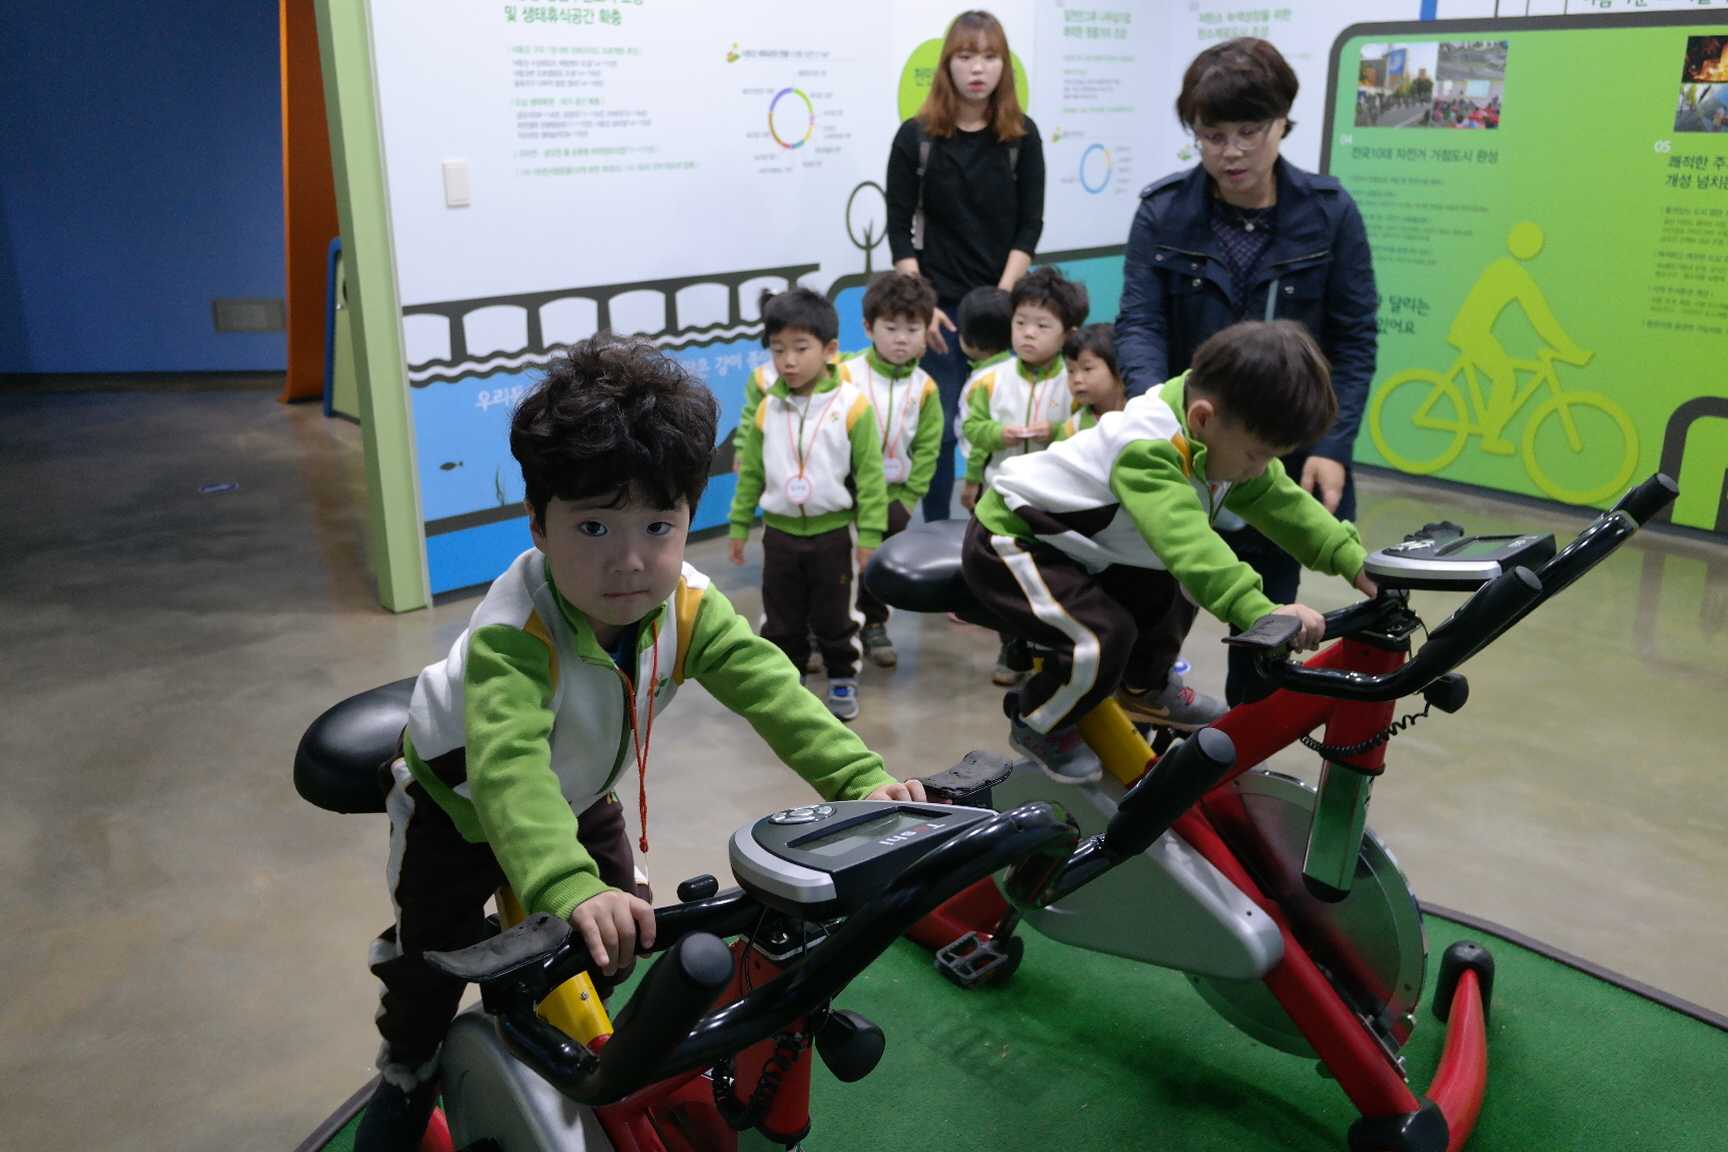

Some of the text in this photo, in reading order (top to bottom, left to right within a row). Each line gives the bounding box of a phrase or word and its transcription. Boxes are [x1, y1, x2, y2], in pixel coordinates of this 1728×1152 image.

[504, 5, 622, 26] 및 생태휴식공간 확충
[1396, 147, 1426, 162] 자전거
[1654, 140, 1671, 153] 05
[1668, 154, 1728, 171] 쾌적한 주
[1665, 173, 1692, 189] 개성
[1389, 295, 1430, 317] 달리는
[878, 822, 946, 846] Toshi
